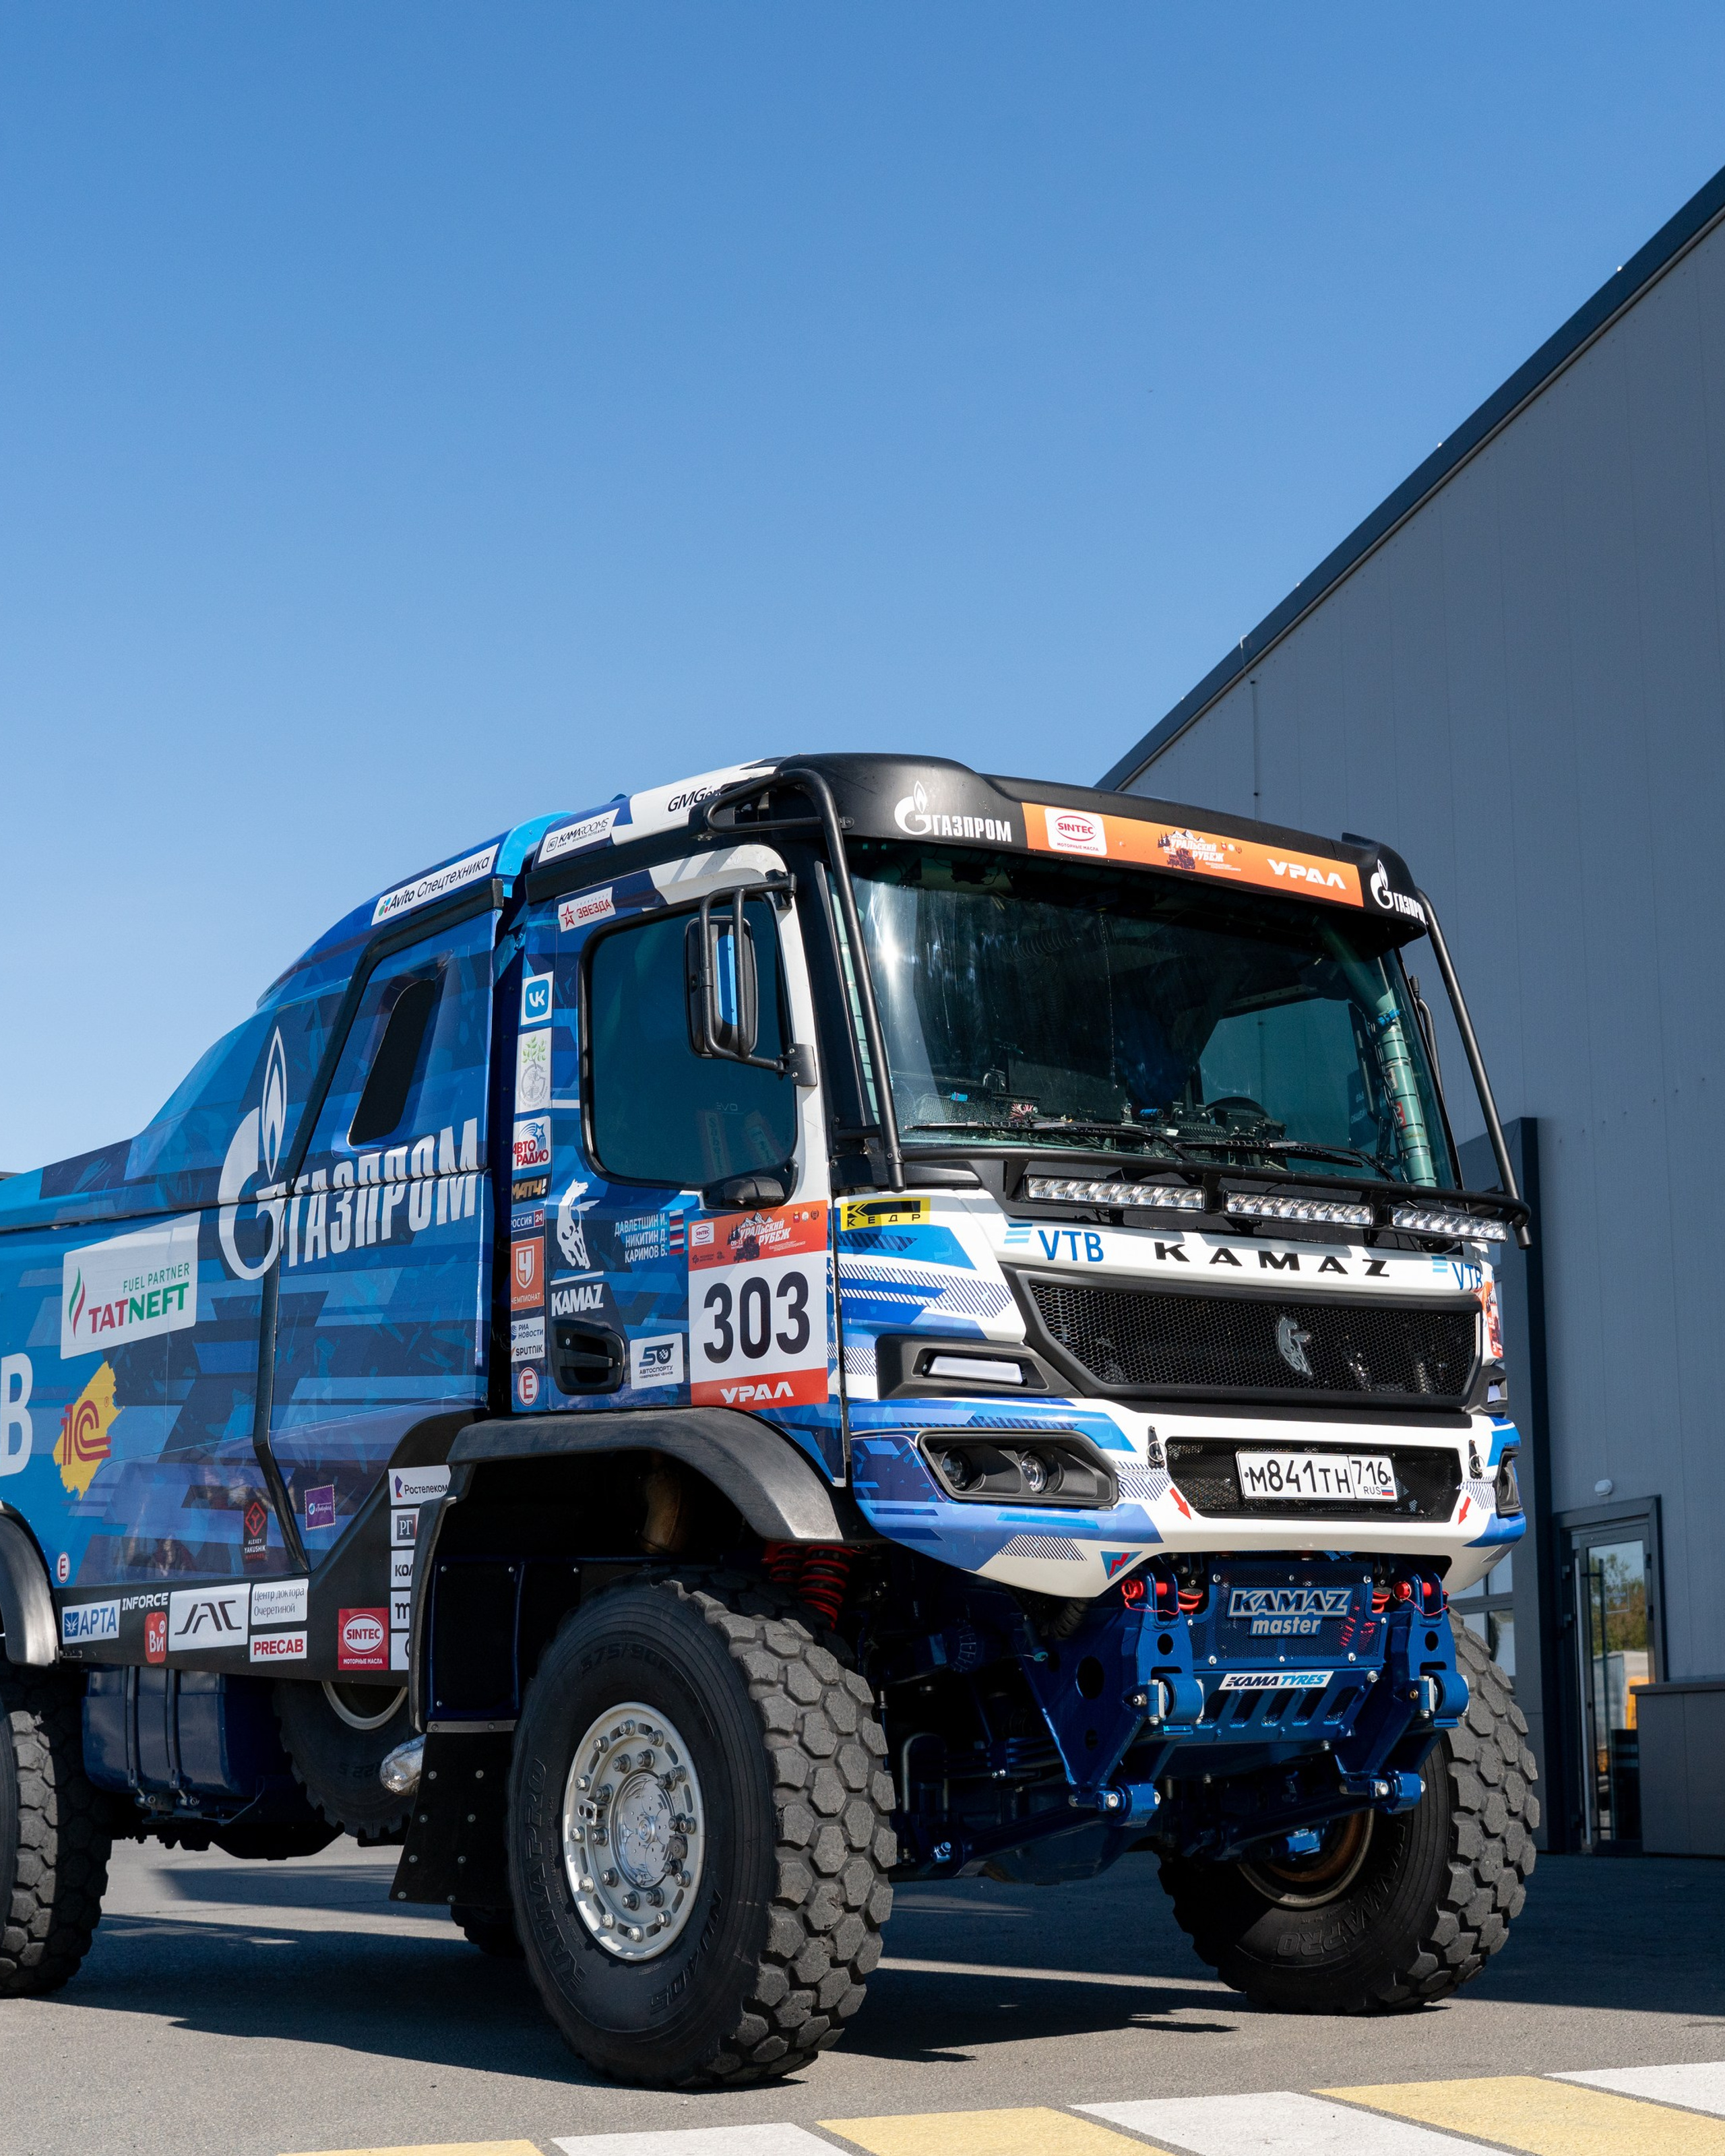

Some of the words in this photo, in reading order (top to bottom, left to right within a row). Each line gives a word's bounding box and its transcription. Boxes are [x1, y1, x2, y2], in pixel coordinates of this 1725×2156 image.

[932, 815, 1012, 842] ГАЗПРОМ
[1058, 823, 1094, 834] SINTEC
[1170, 839, 1217, 852] УРАЛЬСКИЙ
[1192, 850, 1224, 862] РУБЕЖ
[389, 889, 415, 911] Avito
[417, 856, 491, 897] Спецтехника
[1267, 858, 1346, 890] УРАЛ
[576, 899, 612, 919] ЗВЕЗДА
[1393, 892, 1428, 926] ГАЗПРО
[529, 989, 545, 1008] VK
[513, 1139, 536, 1155] АВТО
[516, 1149, 549, 1167] РАДИО
[287, 1118, 478, 1268] ГАЗПРОМ
[535, 1213, 542, 1223] 24
[615, 1214, 658, 1237] ДАВЛЕТШИН
[660, 1213, 667, 1226] И.
[847, 1213, 920, 1227] КЕДР
[625, 1230, 658, 1248] НИКИТИН
[660, 1228, 667, 1244] Д.
[740, 1219, 785, 1240] УРАЛЬСКИЙ
[759, 1228, 791, 1246] РУБЕЖ
[625, 1245, 659, 1263] КАРИМОВ
[661, 1244, 667, 1257] Б.
[1037, 1230, 1104, 1263] VTB
[1155, 1242, 1391, 1277] KAMAZ
[123, 1277, 146, 1294] FUEL
[148, 1263, 189, 1286] PARTNER
[1451, 1262, 1482, 1292] VTB
[88, 1282, 189, 1334] TATNEFT
[551, 1283, 604, 1317] KAMAZ
[518, 1323, 529, 1331] РИА
[703, 1271, 811, 1364] 303
[518, 1329, 544, 1339] НОВОСТИ
[515, 1344, 543, 1356] SPUTNIK
[639, 1365, 673, 1374] АВТОСПОРТУ
[523, 1375, 533, 1399] E
[720, 1381, 794, 1403] УРАЛ
[1351, 1460, 1389, 1486] 716
[404, 1485, 447, 1495] Ростелеком
[1364, 1486, 1381, 1495] RUS
[399, 1520, 412, 1535] РГ
[244, 1545, 266, 1554] YAKUSHIK
[60, 1558, 66, 1577] E
[122, 1593, 168, 1611] INFORCE
[254, 1591, 275, 1602] Центр
[276, 1588, 305, 1599] доктора
[1229, 1590, 1352, 1616] KAMAZ
[254, 1604, 295, 1618] Очеретиной
[80, 1607, 117, 1636] АРТА
[1251, 1616, 1321, 1635] master
[346, 1628, 381, 1640] SINTEC
[253, 1639, 304, 1655] PRECAB
